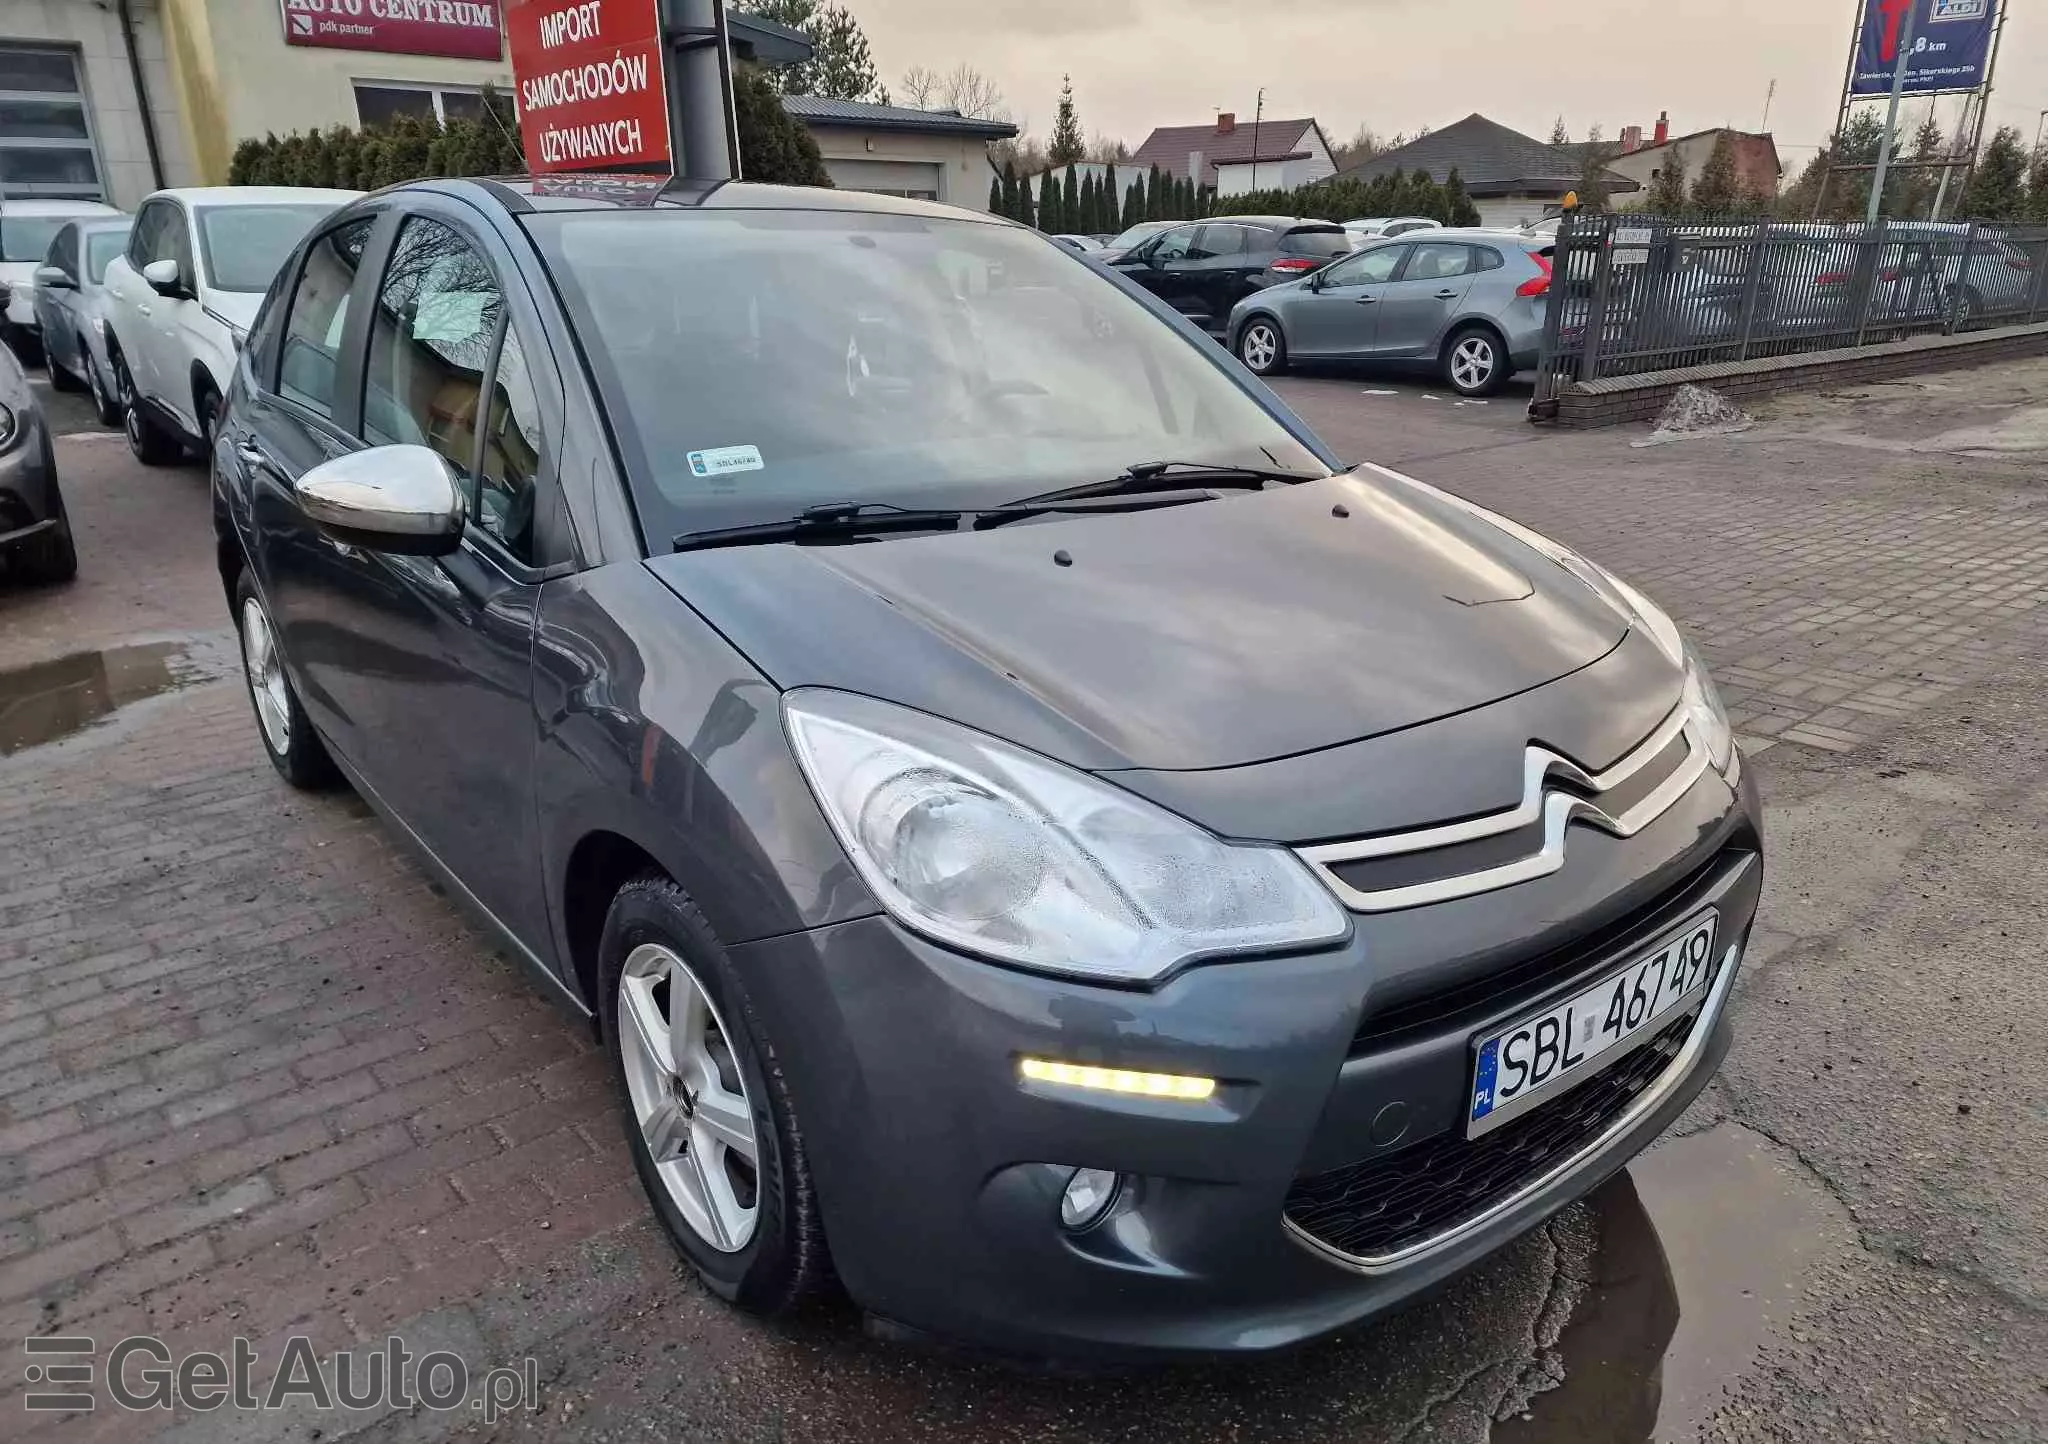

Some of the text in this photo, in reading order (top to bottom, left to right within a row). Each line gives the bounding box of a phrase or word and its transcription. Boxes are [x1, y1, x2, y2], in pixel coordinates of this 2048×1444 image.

[319, 20, 374, 35] pdk partner
[369, 0, 494, 28] CENTRUM
[539, 1, 601, 50] IMPORT
[1928, 41, 1947, 51] km
[522, 49, 648, 112] SAMOCHODÓW
[539, 118, 643, 163] UŻYWANYCH
[1474, 928, 1710, 1111] PL SBL 46749
